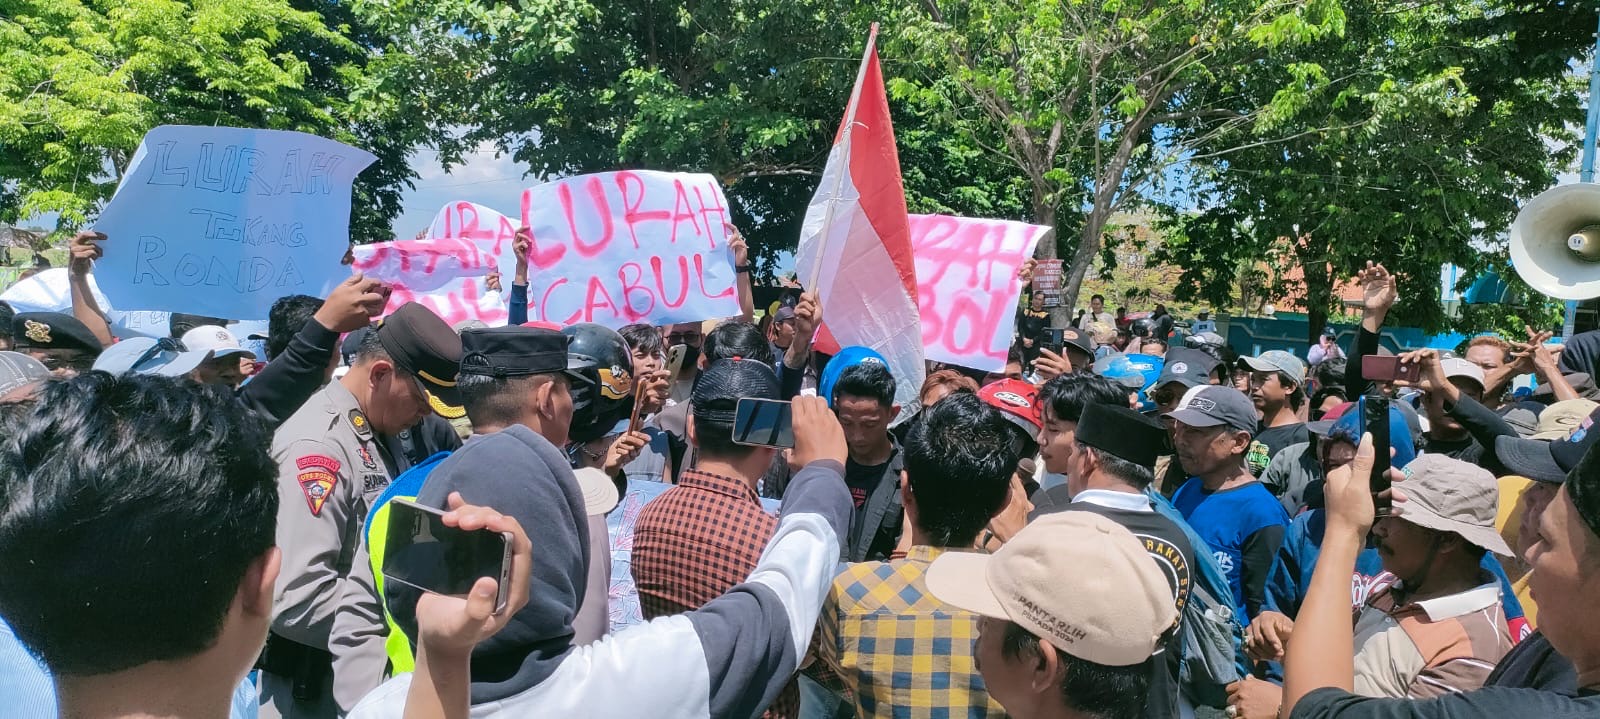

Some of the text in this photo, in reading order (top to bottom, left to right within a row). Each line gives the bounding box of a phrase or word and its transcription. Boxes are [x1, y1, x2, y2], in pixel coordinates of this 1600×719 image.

[147, 141, 346, 197] LURAH
[189, 208, 308, 248] TUKANG
[521, 170, 728, 270] LURAH
[133, 235, 305, 294] RONDA
[909, 214, 1038, 295] RAH
[541, 253, 735, 323] CABUL
[917, 289, 1012, 361] BOL
[1147, 540, 1186, 572] RAKAT
[1018, 595, 1087, 641] PANTARLIH
[1022, 610, 1054, 633] PILKADA
